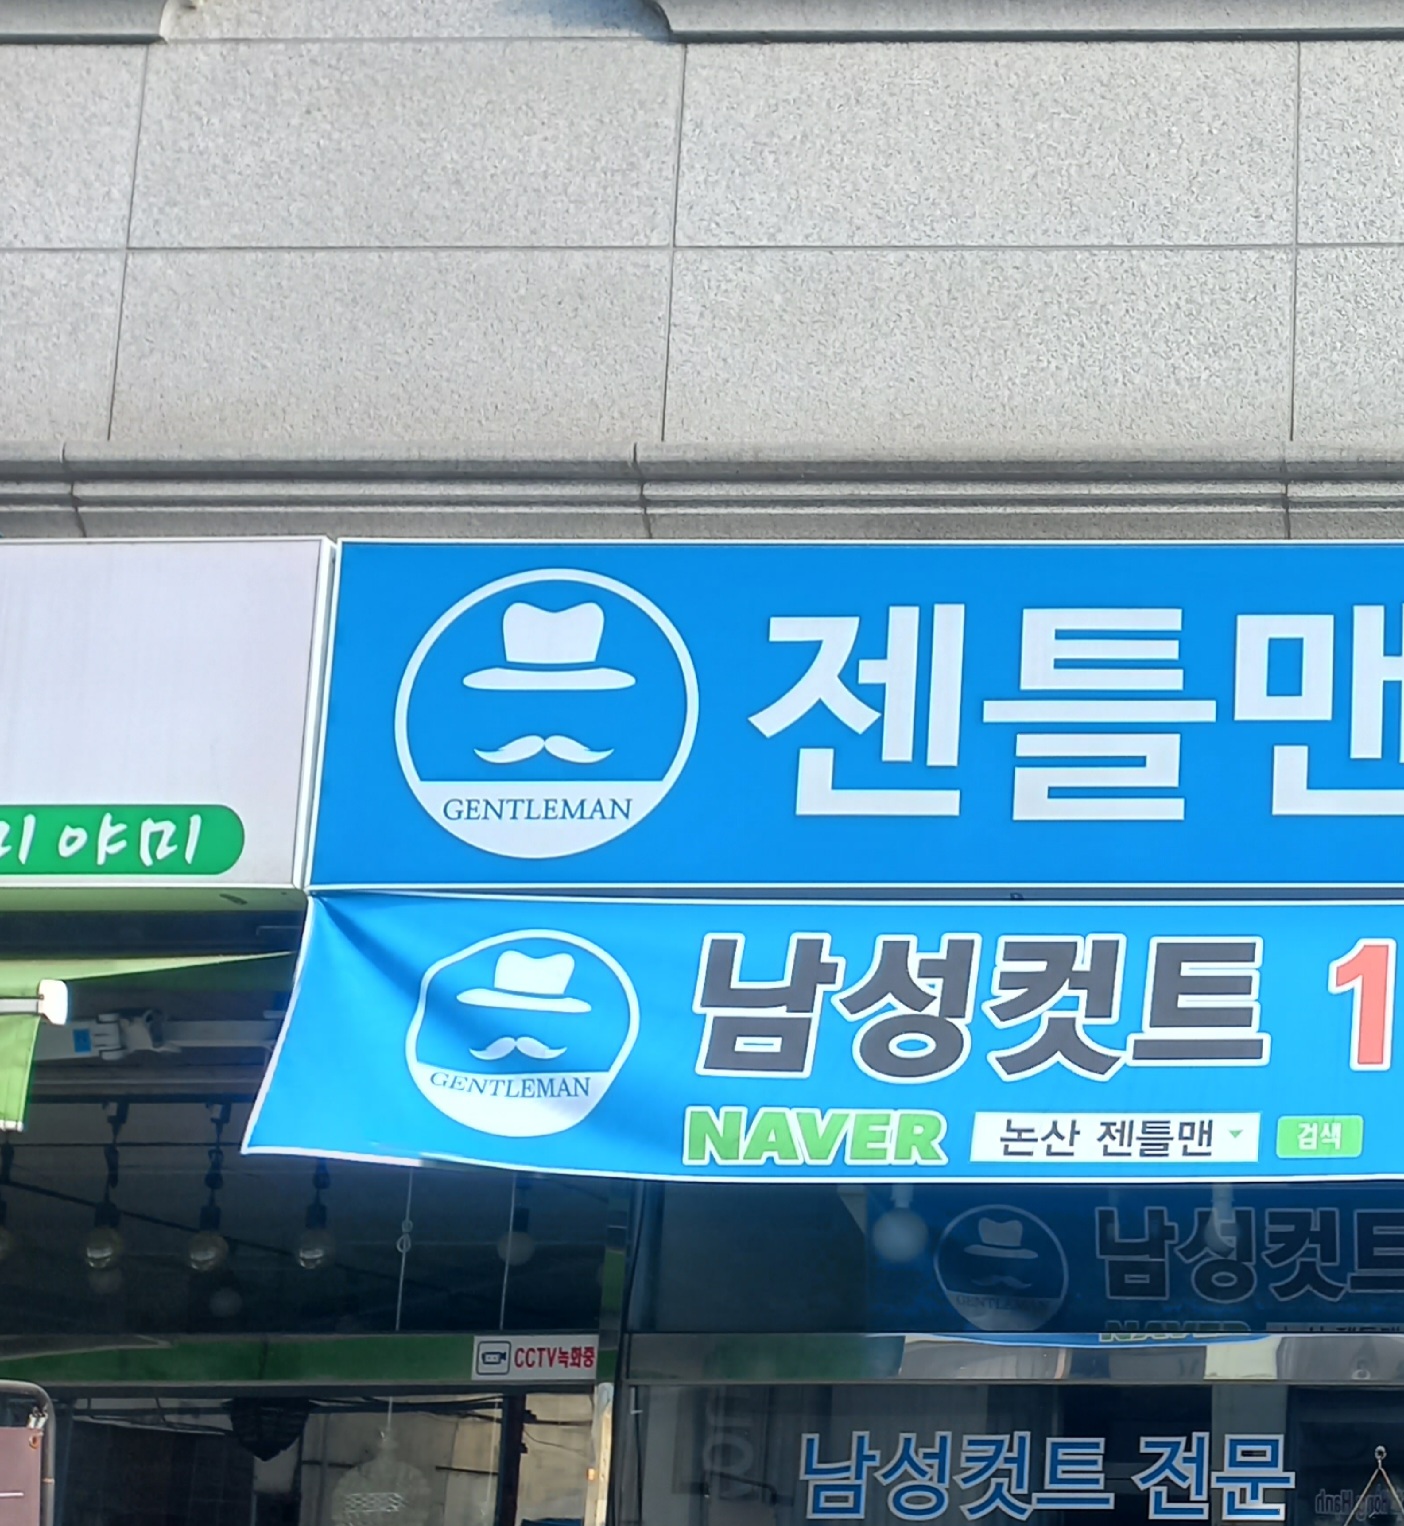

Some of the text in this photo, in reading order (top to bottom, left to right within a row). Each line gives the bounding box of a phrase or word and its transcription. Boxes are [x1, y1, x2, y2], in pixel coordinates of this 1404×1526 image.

[443, 796, 634, 824] GENTLEMAN
[57, 812, 203, 867] 야미
[692, 933, 1271, 1083] 남성컷트
[429, 1070, 591, 1101] GENTLEMAN
[683, 1106, 948, 1167] NAVER
[999, 1113, 1215, 1161] 논산 젠틀맨
[1295, 1122, 1342, 1152] 검색
[800, 1431, 1115, 1520] 남성컷트
[1131, 1431, 1297, 1520] 전문
